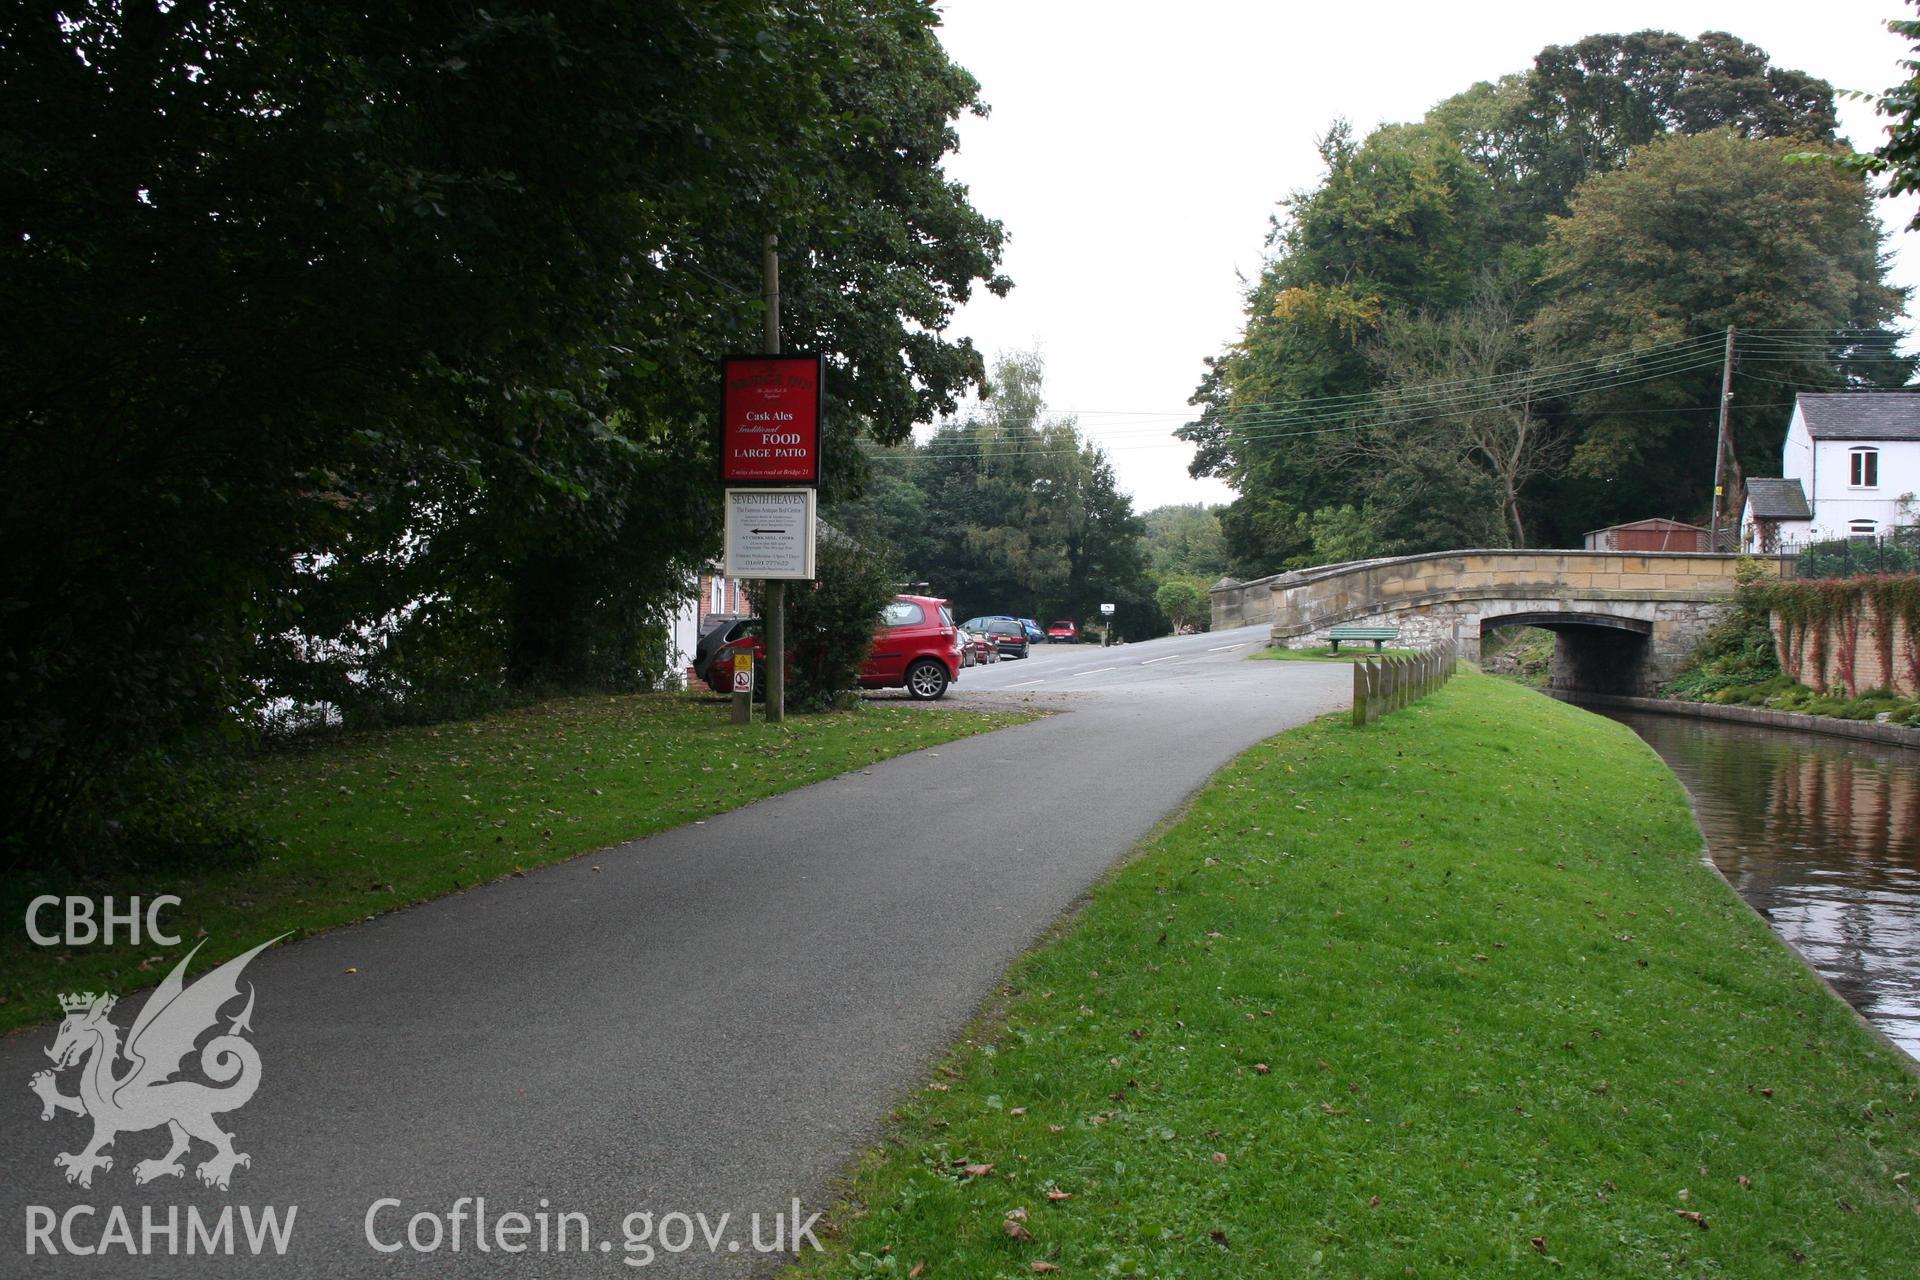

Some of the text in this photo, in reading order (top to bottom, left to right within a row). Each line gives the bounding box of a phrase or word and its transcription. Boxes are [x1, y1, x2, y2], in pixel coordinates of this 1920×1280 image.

[746, 411, 793, 421] Cask Ales
[736, 424, 780, 433] Traditional
[762, 433, 801, 445] FOOD
[734, 448, 807, 458] LARGE PATIO
[783, 468, 801, 477] Bridge
[732, 495, 805, 505] SEVENTH HEAVEN
